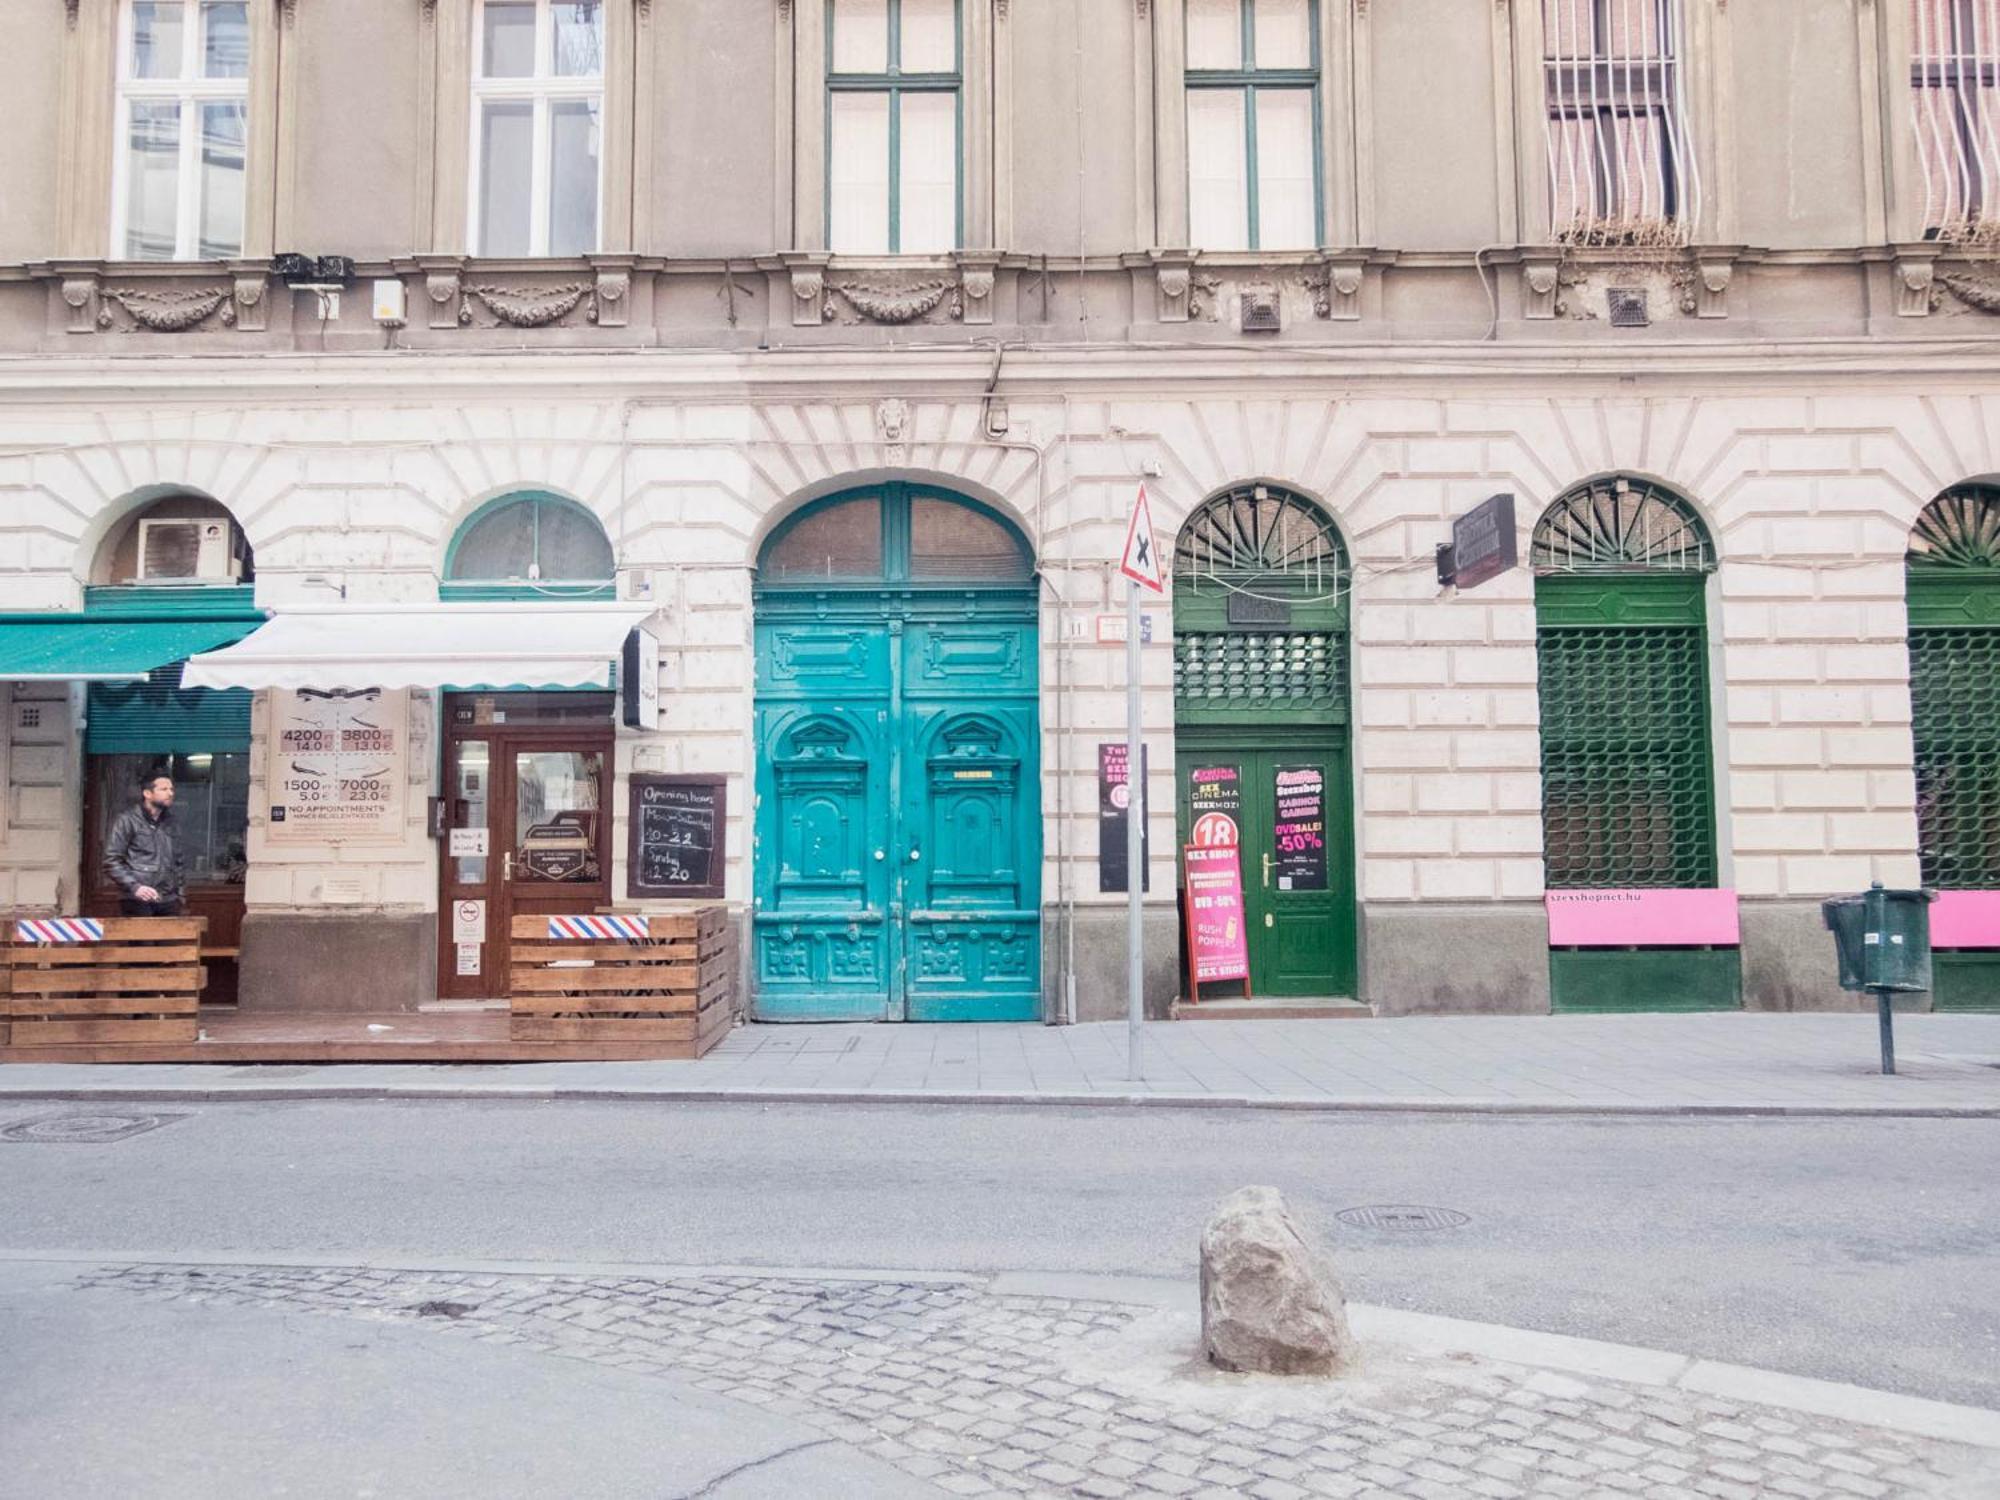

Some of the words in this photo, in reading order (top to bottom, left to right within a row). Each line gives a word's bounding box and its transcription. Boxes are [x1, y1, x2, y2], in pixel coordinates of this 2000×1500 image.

[284, 730, 322, 740] 4200
[342, 730, 381, 740] 3800
[296, 741, 322, 751] 14.0
[354, 741, 380, 751] 13.0
[284, 780, 320, 790] 1500
[340, 780, 379, 790] 7000
[300, 791, 320, 801] 5.0
[350, 791, 379, 801] 23.0
[1192, 789, 1239, 800] CINEMA
[306, 805, 385, 813] APPOINTMENTS
[1200, 818, 1231, 845] 18
[1277, 832, 1323, 851] -50%
[1187, 850, 1207, 860] SEX
[1197, 967, 1217, 977] SEX
